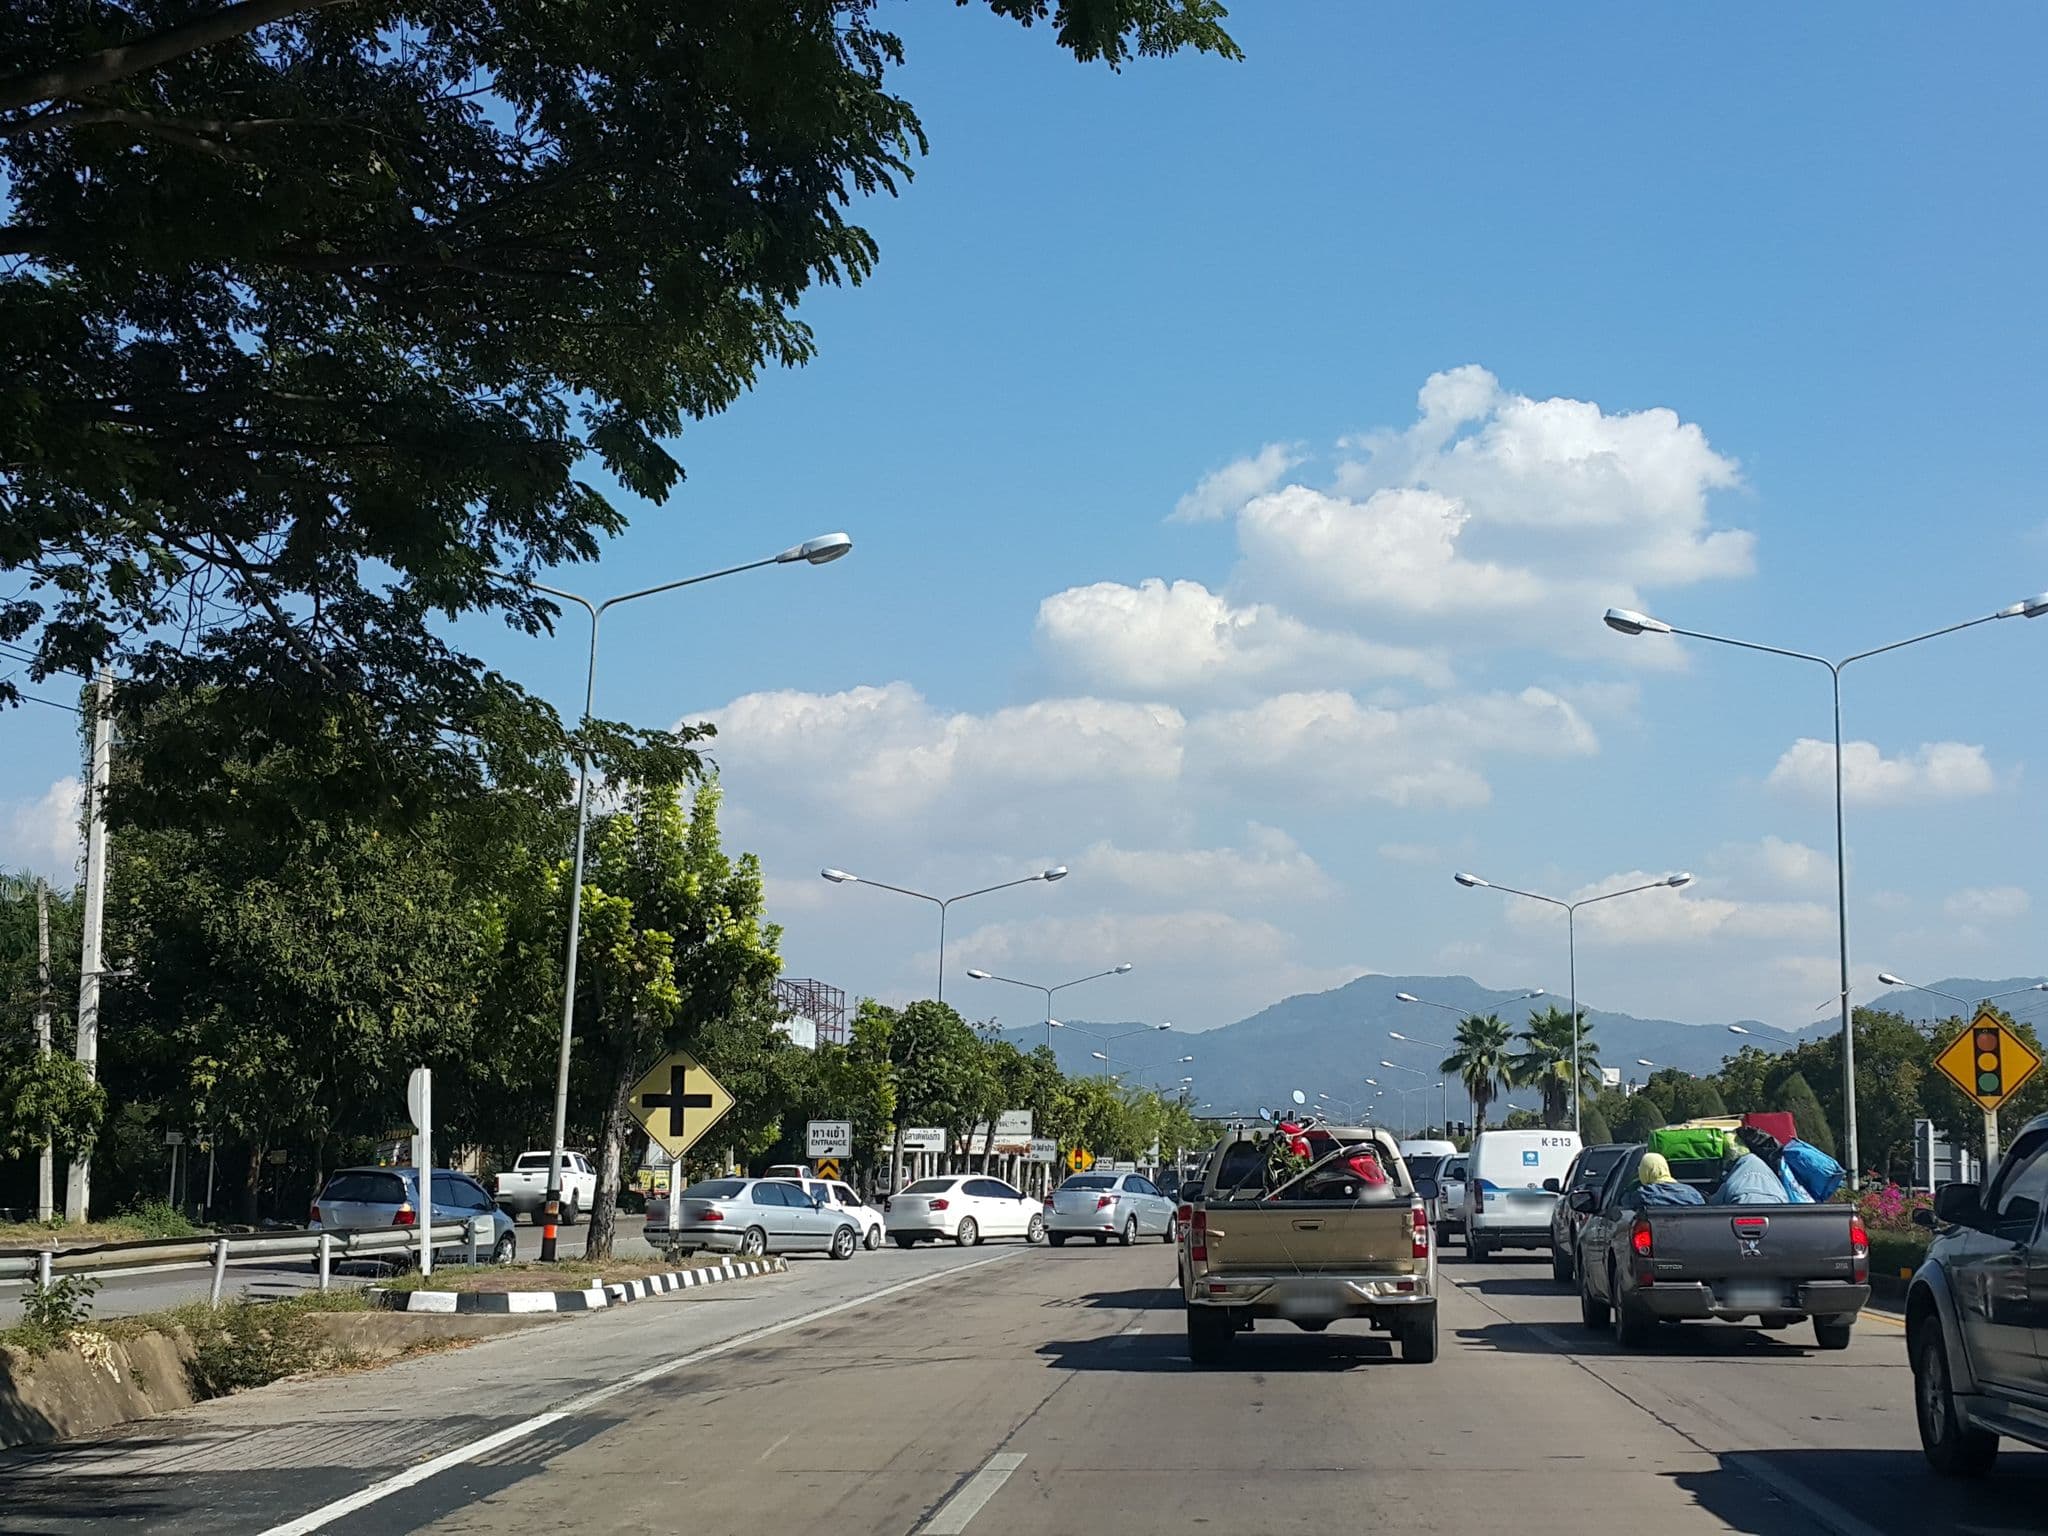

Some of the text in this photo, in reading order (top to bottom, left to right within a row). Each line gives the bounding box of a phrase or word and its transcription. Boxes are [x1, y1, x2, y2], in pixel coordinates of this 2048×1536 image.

[812, 1125, 845, 1138] ทางเข้า
[1541, 1137, 1571, 1147] K-213
